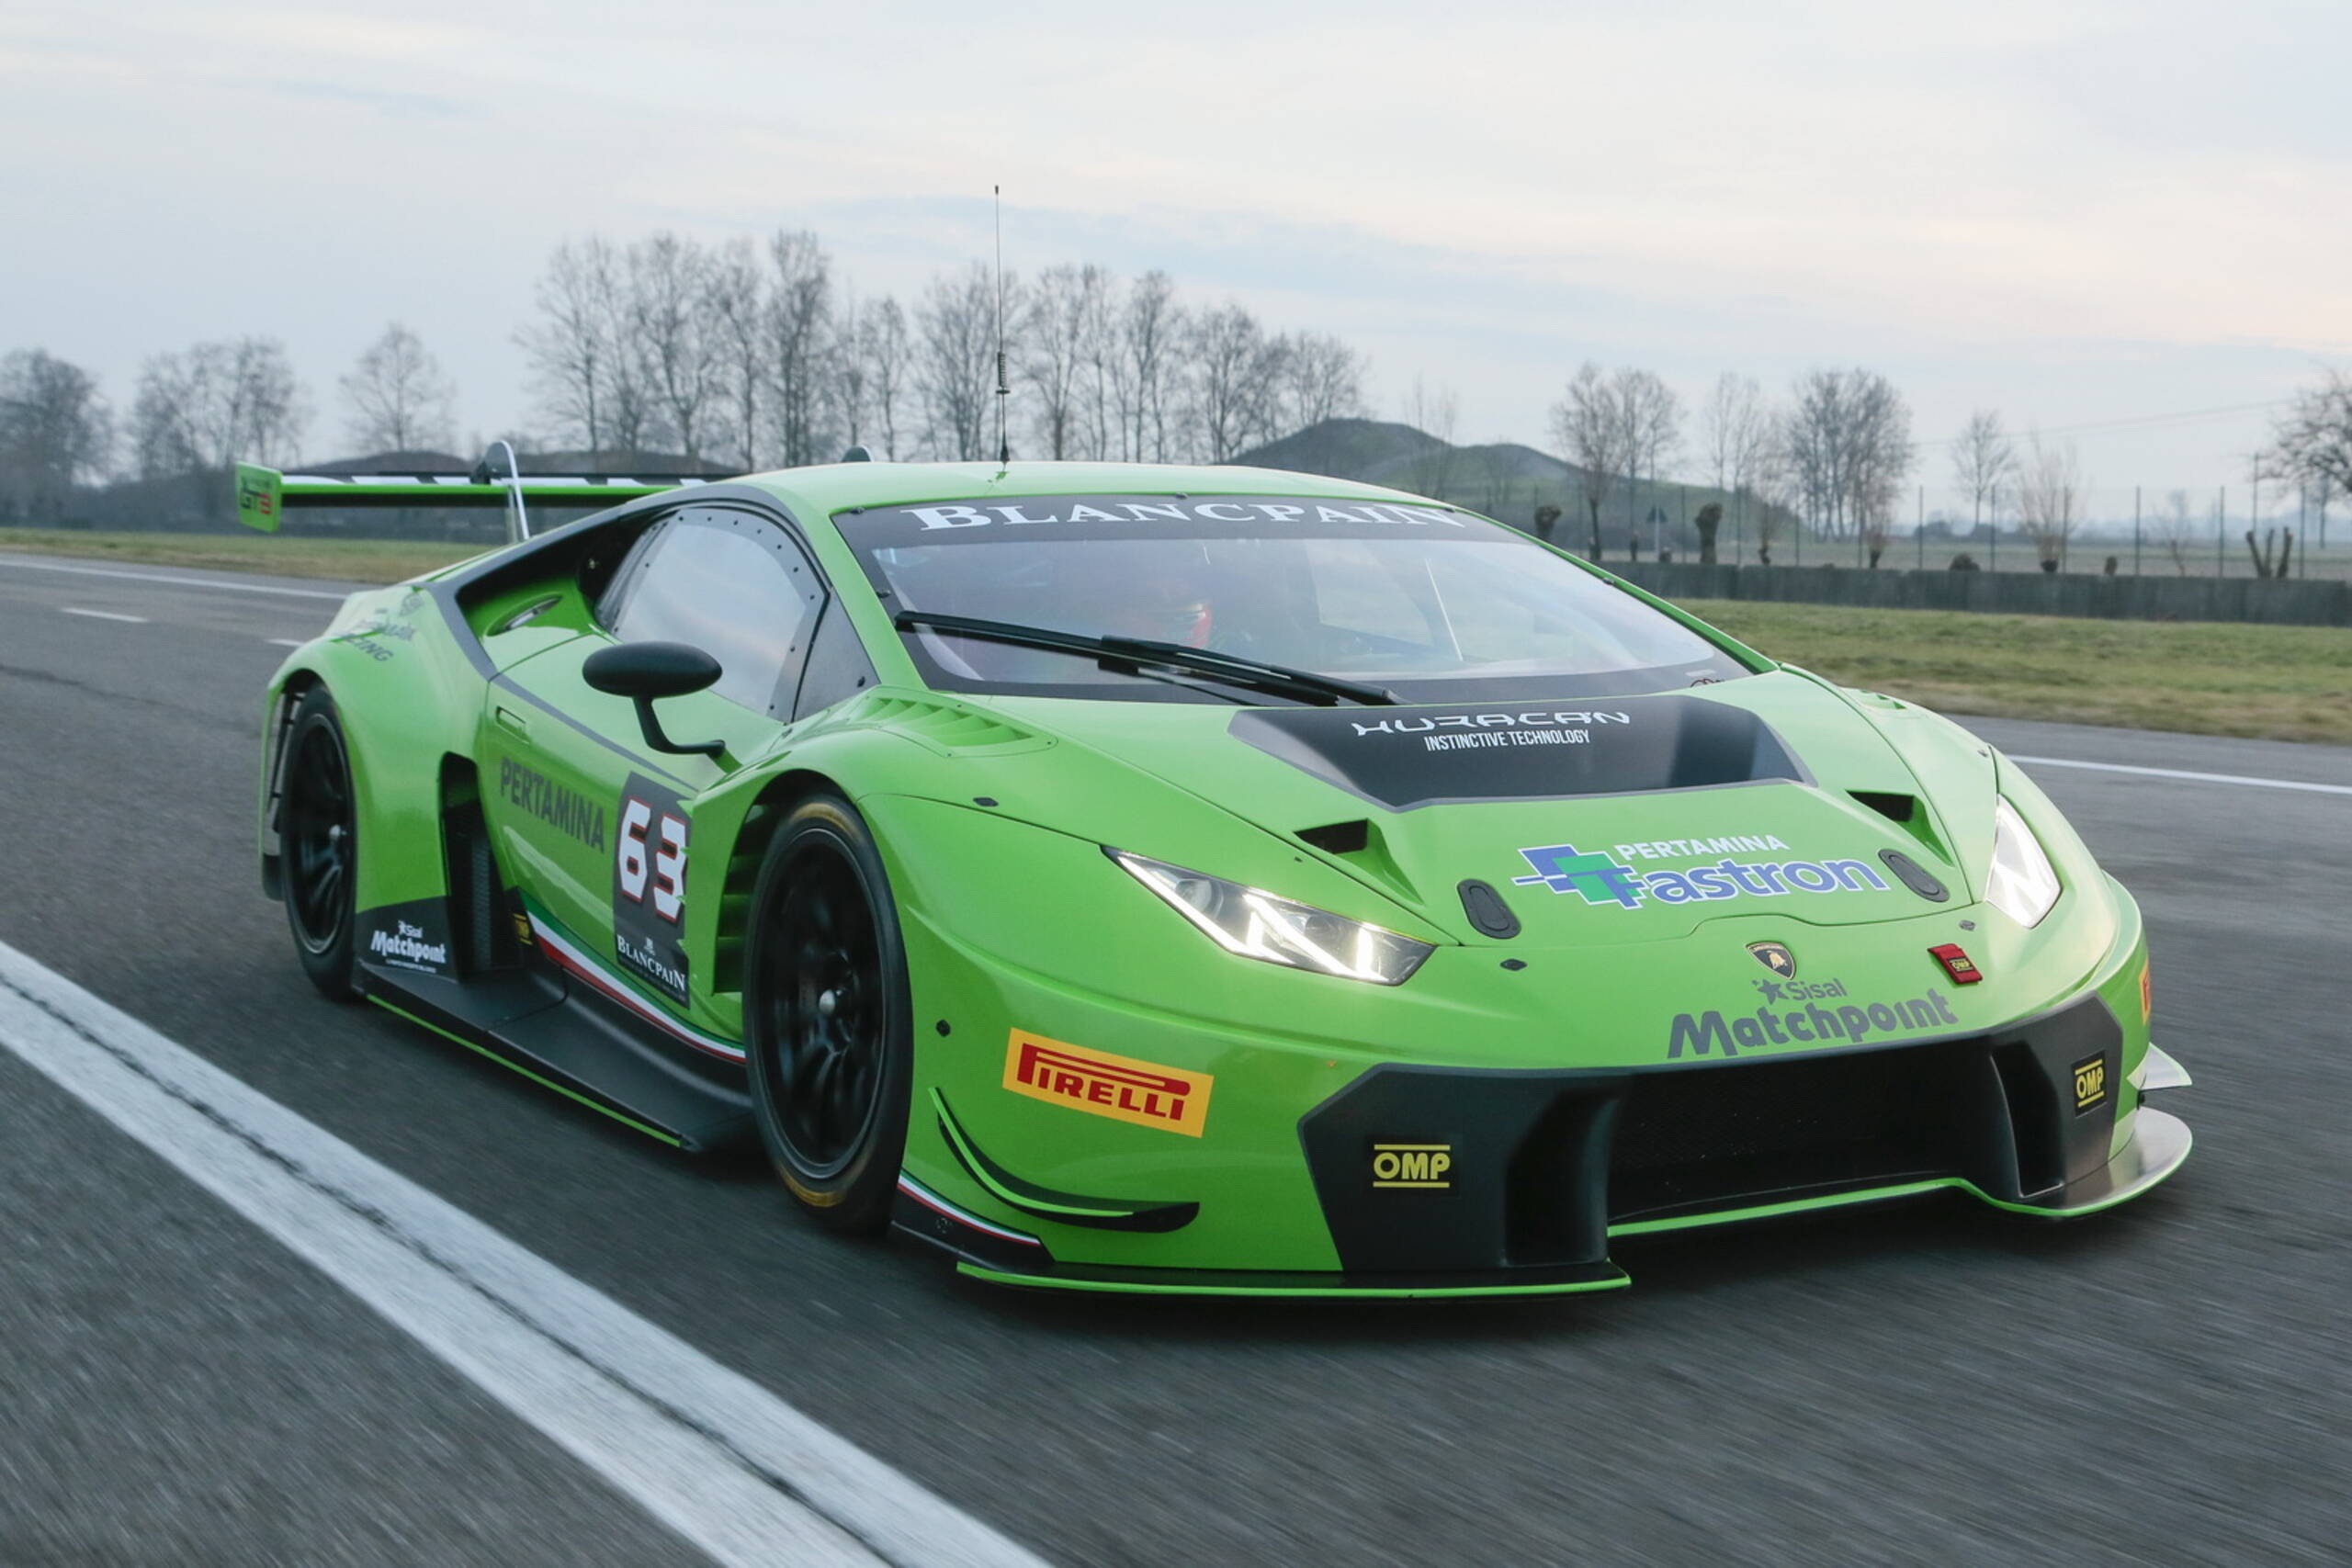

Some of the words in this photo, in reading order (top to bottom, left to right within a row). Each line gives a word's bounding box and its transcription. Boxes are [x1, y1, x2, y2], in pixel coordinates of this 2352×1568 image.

[899, 502, 1465, 532] BLANCPAIN
[1424, 731, 1508, 752] INSTINCTIVE
[1506, 728, 1591, 747] TECHNOLOGY
[500, 756, 605, 854] PERTAMINA
[617, 796, 688, 923] 63
[1613, 834, 1791, 862] PERTAMINA
[1569, 858, 1892, 910] Fastron
[370, 930, 447, 964] Matchpoint
[616, 933, 686, 992] BLANCPAIN
[1785, 978, 1849, 1001] Sisal
[1667, 988, 1960, 1060] Matchpoint
[1016, 1043, 1192, 1122] PIRELLI
[2075, 1066, 2105, 1100] OMP
[1374, 1151, 1451, 1180] OMP
